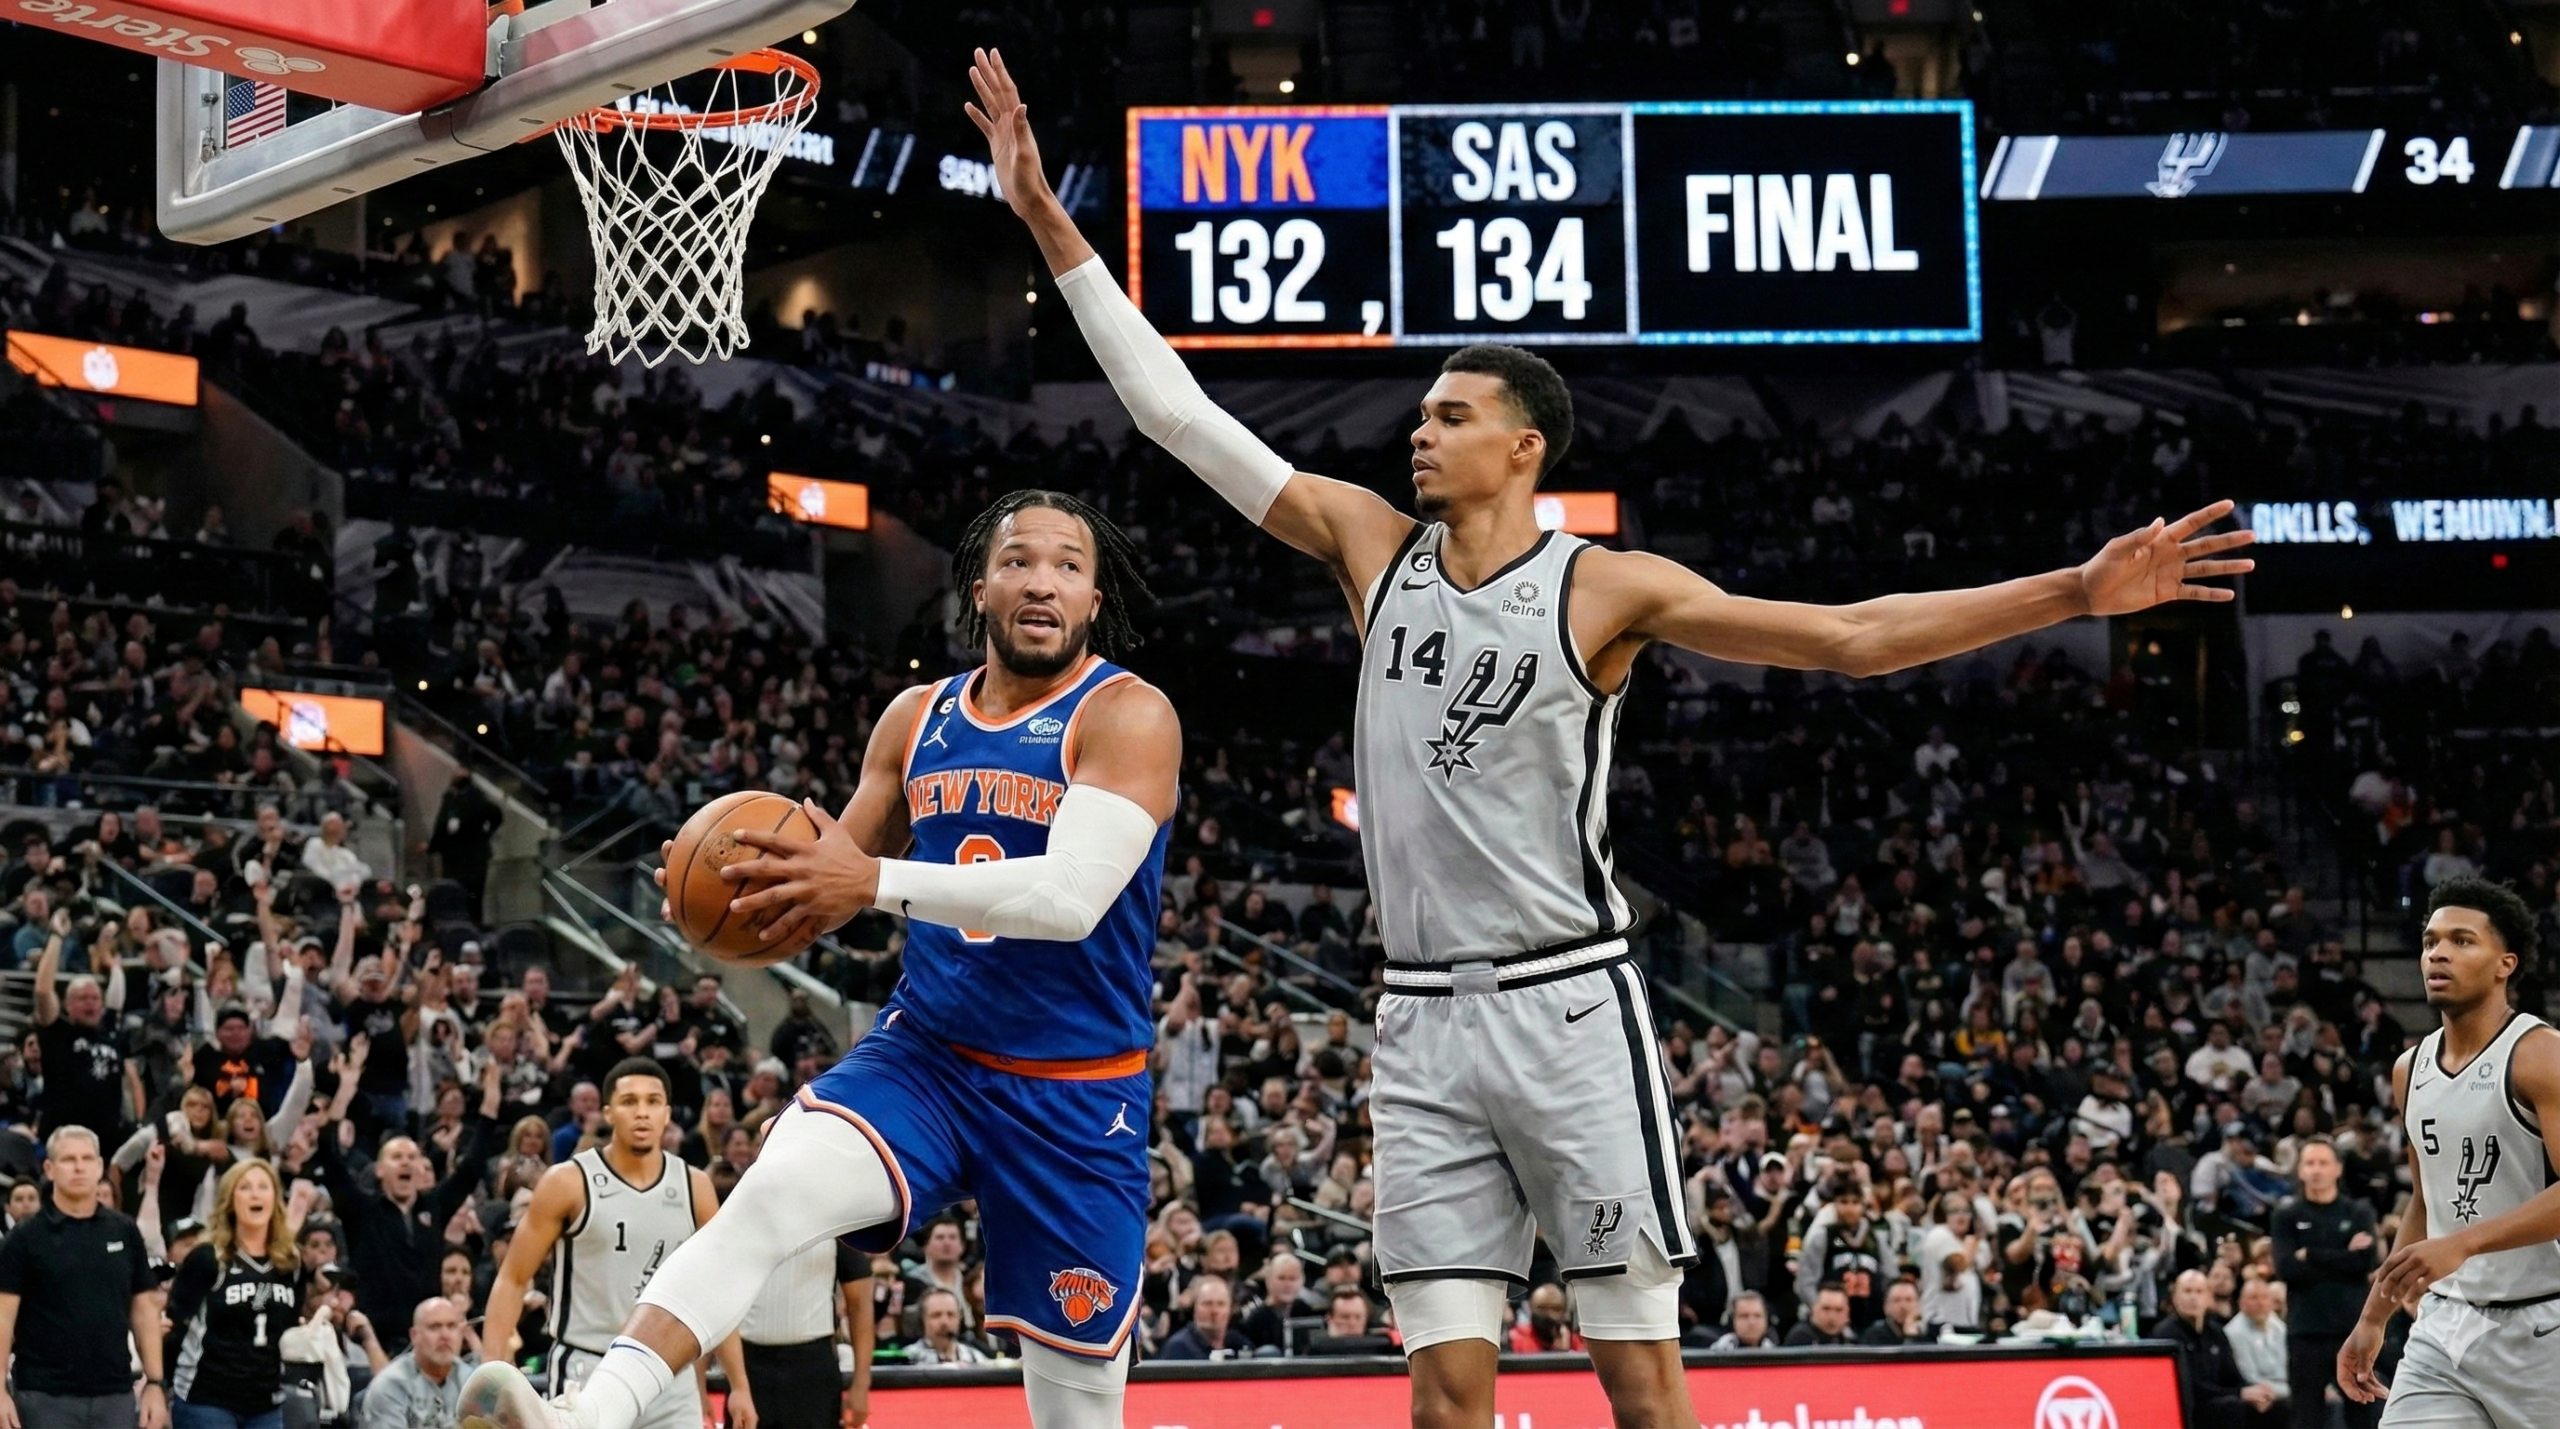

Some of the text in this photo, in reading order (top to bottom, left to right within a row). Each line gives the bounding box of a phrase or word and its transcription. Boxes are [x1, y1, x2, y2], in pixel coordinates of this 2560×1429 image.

[1182, 124, 1315, 203] NYK
[1451, 121, 1577, 202] SAS
[2404, 136, 2475, 185] 34
[1686, 173, 1919, 272] FINAL
[1174, 219, 1326, 324] 132
[1436, 217, 1593, 322] 134
[1385, 625, 1448, 688] 14
[907, 768, 1065, 827] NEW YORK
[2420, 1118, 2440, 1156] 5
[614, 1220, 628, 1253] 1
[253, 1312, 268, 1347] 1
